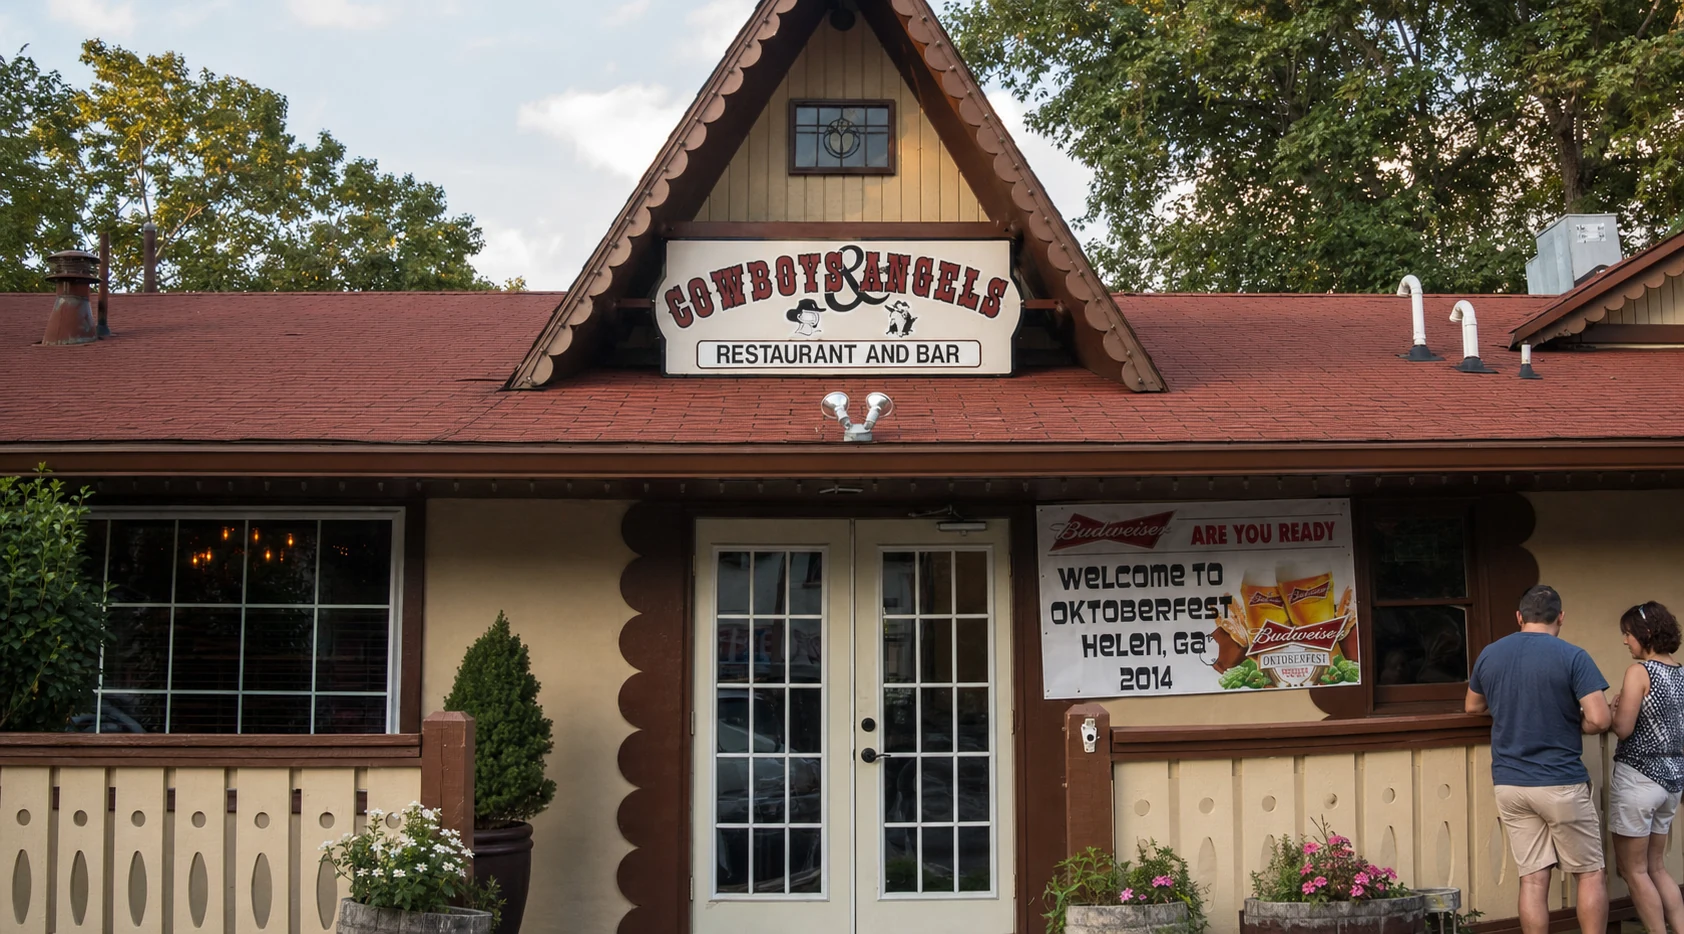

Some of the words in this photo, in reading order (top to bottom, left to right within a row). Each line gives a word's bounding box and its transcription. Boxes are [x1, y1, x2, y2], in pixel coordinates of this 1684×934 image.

[664, 251, 843, 329] COWBOYS
[825, 245, 890, 312] &
[859, 252, 1009, 319] ANGELS
[716, 344, 857, 364] RESTAURANT
[865, 344, 909, 363] AND
[917, 344, 960, 363] BAR
[1049, 520, 1172, 541] Budweiser
[1191, 524, 1228, 545] ARE
[1232, 523, 1272, 544] YOU
[1279, 521, 1336, 543] READY
[1192, 562, 1223, 586] TO
[1248, 626, 1345, 644] Budweiser
[1263, 653, 1327, 666] OKTOBERFEST
[1120, 665, 1173, 691] 2014
